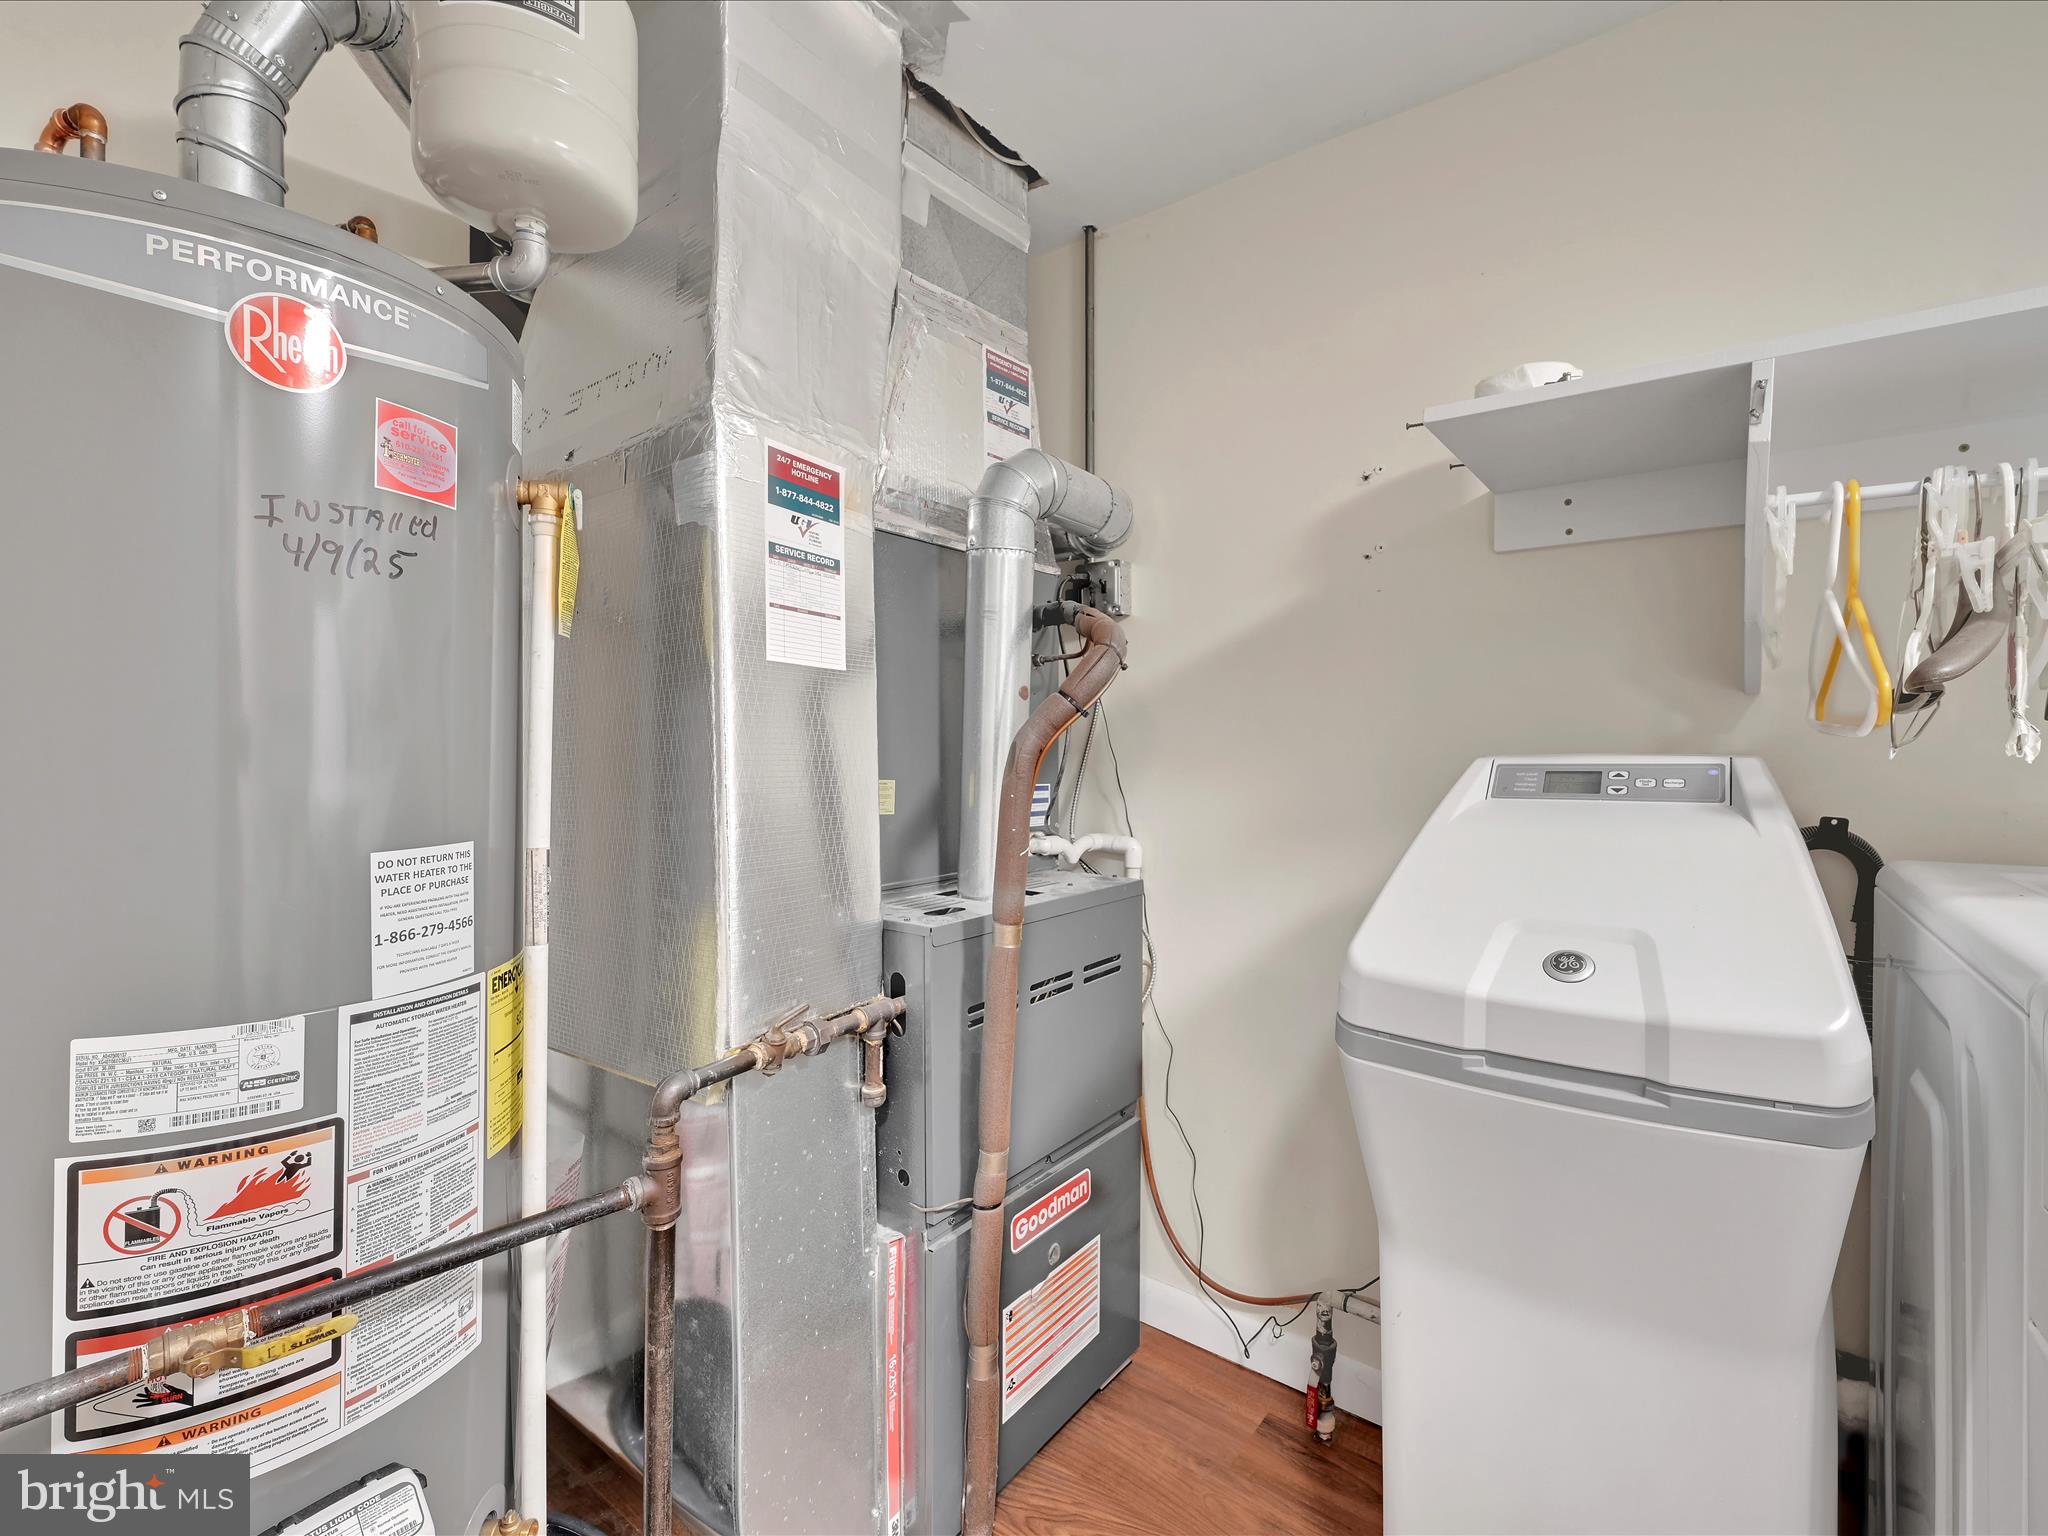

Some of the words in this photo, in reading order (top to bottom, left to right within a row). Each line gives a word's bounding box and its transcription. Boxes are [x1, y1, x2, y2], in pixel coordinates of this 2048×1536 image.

[391, 427, 447, 453] service
[393, 420, 410, 430] call
[414, 425, 426, 436] for
[777, 454, 791, 464] 24/7
[792, 460, 832, 480] EMERGENCY
[791, 468, 819, 484] HOTLINE
[776, 486, 834, 512] 1-877-844-4822
[283, 533, 417, 579] 4/9/25
[775, 545, 805, 560] SERVICE
[807, 551, 834, 567] RECORD
[374, 870, 410, 884] WATER
[413, 866, 445, 878] HEATER
[447, 864, 457, 873] TO
[460, 862, 472, 871] THE
[377, 859, 393, 869] DO
[397, 856, 417, 867] NOT
[420, 852, 453, 864] RETURN
[455, 849, 470, 859] THIS
[381, 884, 411, 897] PLACE
[414, 882, 426, 892] OF
[428, 875, 468, 889] PURCHASE
[374, 915, 472, 947] 1-866-279-4566
[372, 1002, 413, 1020] INSTALLATION
[413, 1000, 425, 1008] AND
[426, 992, 452, 1005] OPERATION
[452, 988, 468, 998] DETAILS
[375, 1014, 410, 1030] AUTOMATIC
[410, 1009, 434, 1021] STORAGE
[435, 1004, 450, 1014] WATER
[177, 1144, 268, 1170] WARNING
[372, 1166, 383, 1176] FOR
[384, 1160, 398, 1171] YOUR
[398, 1153, 416, 1166] SAFETY
[417, 1148, 428, 1158] READ
[429, 1141, 444, 1152] BEFORE
[445, 1131, 464, 1145] OPERATING
[206, 1213, 255, 1232] Flammable
[258, 1206, 288, 1220] Vapors
[1015, 1181, 1087, 1240] Goodman
[96, 1278, 107, 1287] Do
[109, 1276, 121, 1285] not
[123, 1273, 141, 1283] store
[153, 1269, 167, 1277] use
[169, 1262, 200, 1275] gasoline
[211, 1255, 229, 1265] other
[231, 1245, 267, 1260] flammable
[269, 1239, 292, 1250] vapors
[294, 1234, 307, 1243] and
[308, 1227, 328, 1238] liquids
[140, 1262, 156, 1272] Can
[158, 1258, 181, 1268] result
[193, 1249, 222, 1261] serious
[224, 1244, 246, 1254] injury
[259, 1235, 279, 1245] death
[147, 1253, 166, 1263] FIRE
[168, 1249, 187, 1259] AND
[189, 1238, 237, 1254] EXPLOSION
[240, 1229, 273, 1243] HAZARD
[396, 1244, 418, 1260] LIGHTING
[418, 1228, 448, 1248] INSTRUCTIONS
[87, 1286, 99, 1295] the
[101, 1282, 125, 1295] vicinity
[127, 1281, 135, 1289] of
[136, 1279, 149, 1288] this
[161, 1275, 175, 1284] any
[177, 1270, 195, 1279] other
[237, 1253, 264, 1266] Storage
[305, 1233, 331, 1246] gasoline
[88, 1292, 106, 1302] other
[109, 1284, 147, 1301] flammable
[149, 1280, 175, 1292] vapors
[186, 1272, 210, 1284] liquids
[220, 1267, 231, 1275] the
[232, 1261, 256, 1273] vicinity
[267, 1255, 279, 1263] this
[289, 1249, 301, 1257] any
[303, 1242, 319, 1252] other
[79, 1296, 114, 1312] appliance
[116, 1296, 129, 1304] can
[131, 1291, 152, 1302] result
[162, 1283, 189, 1296] serious
[191, 1279, 211, 1290] injury
[218, 1375, 255, 1390] Temperature
[255, 1368, 277, 1379] limiting
[278, 1361, 295, 1373] valves
[387, 1374, 401, 1386] TURN
[401, 1368, 411, 1377] GAS
[411, 1362, 420, 1371] OFF
[421, 1357, 428, 1365] TO
[427, 1352, 436, 1360] THE
[436, 1337, 457, 1353] APPLIANCE
[162, 1393, 183, 1403] BURN
[182, 1406, 261, 1442] WARNING
[227, 1429, 245, 1439] operate
[227, 1440, 244, 1450] operate
[329, 1508, 355, 1529] LIGHT
[357, 1494, 382, 1512] CODE
